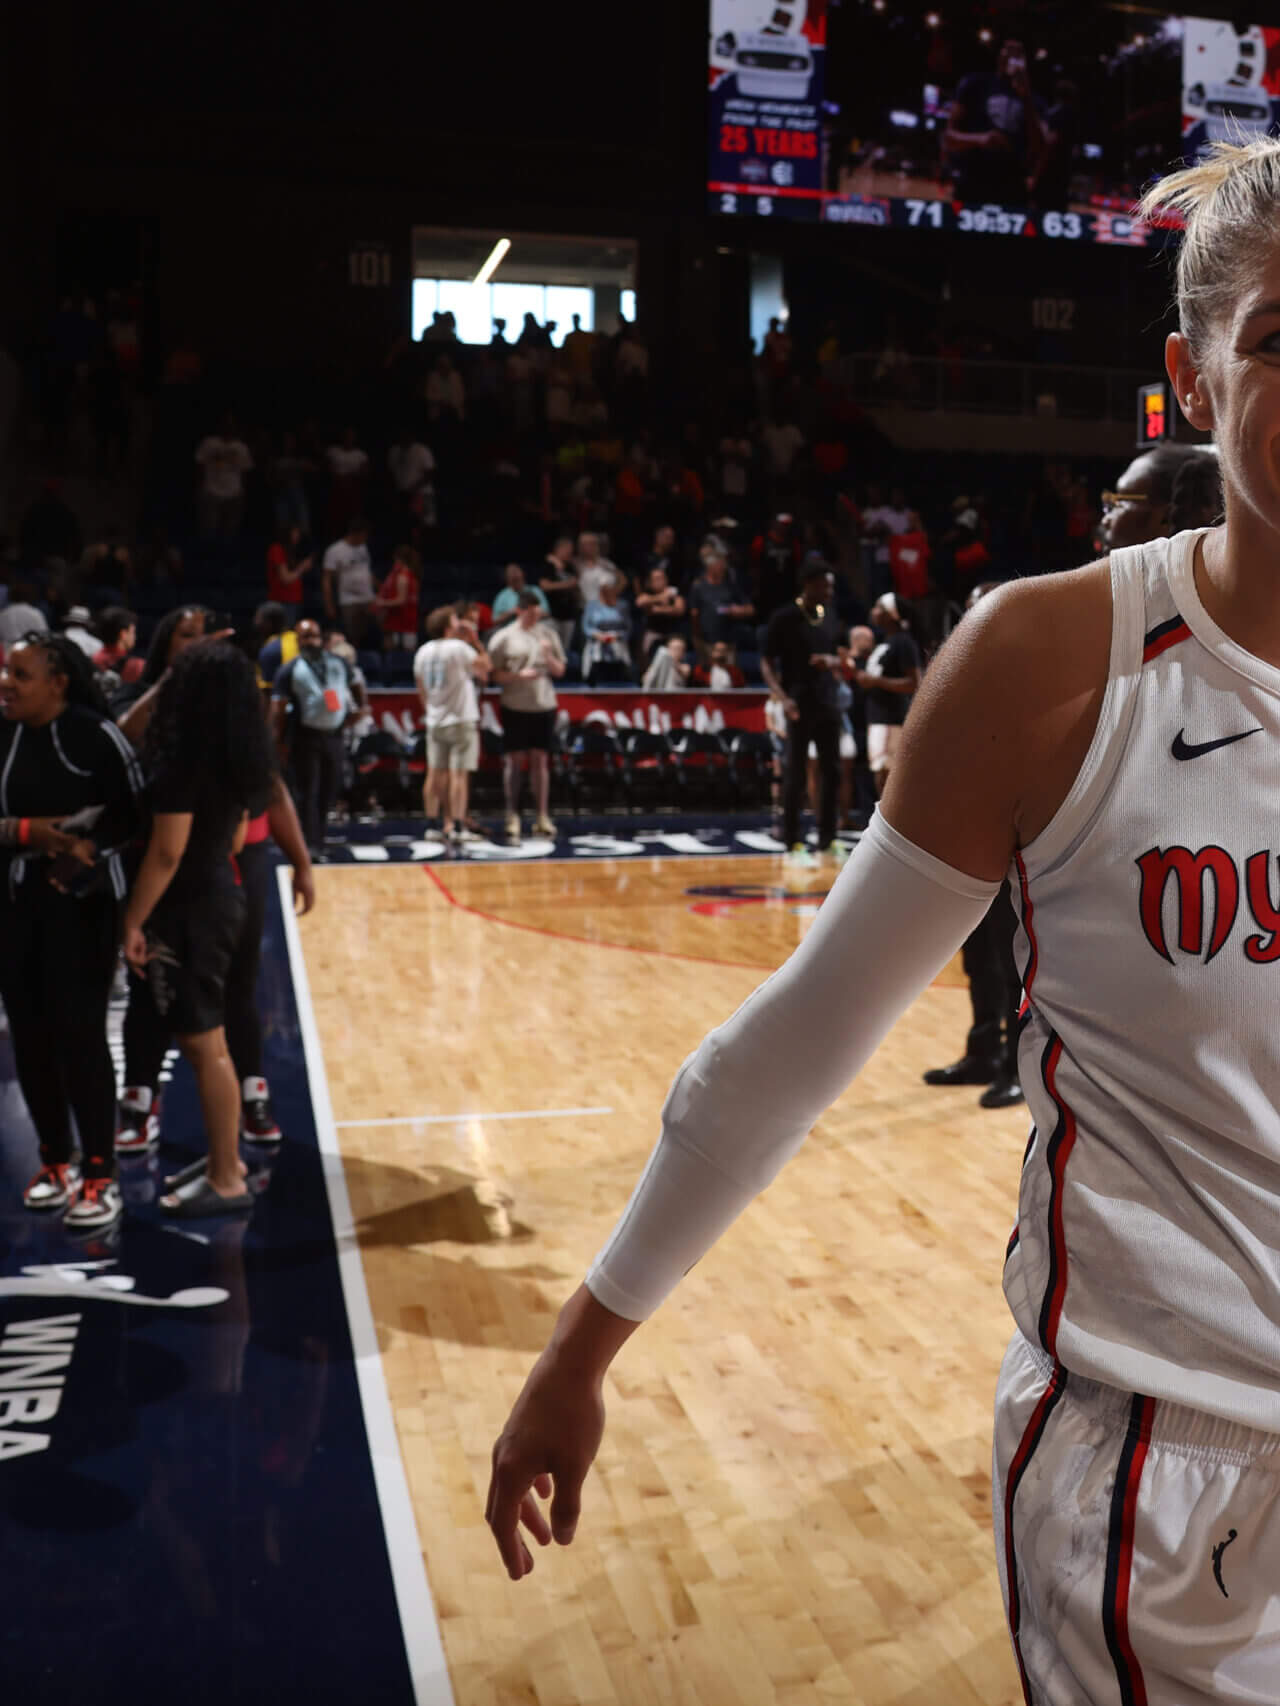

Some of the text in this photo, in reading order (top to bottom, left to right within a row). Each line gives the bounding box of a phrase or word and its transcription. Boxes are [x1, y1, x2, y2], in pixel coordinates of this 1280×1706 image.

[720, 124, 818, 159] 25 YEARS
[905, 200, 944, 228] 71
[1043, 212, 1082, 239] 63
[350, 251, 392, 286] 101
[1031, 297, 1077, 331] 102
[0, 1312, 82, 1460] WNBA
